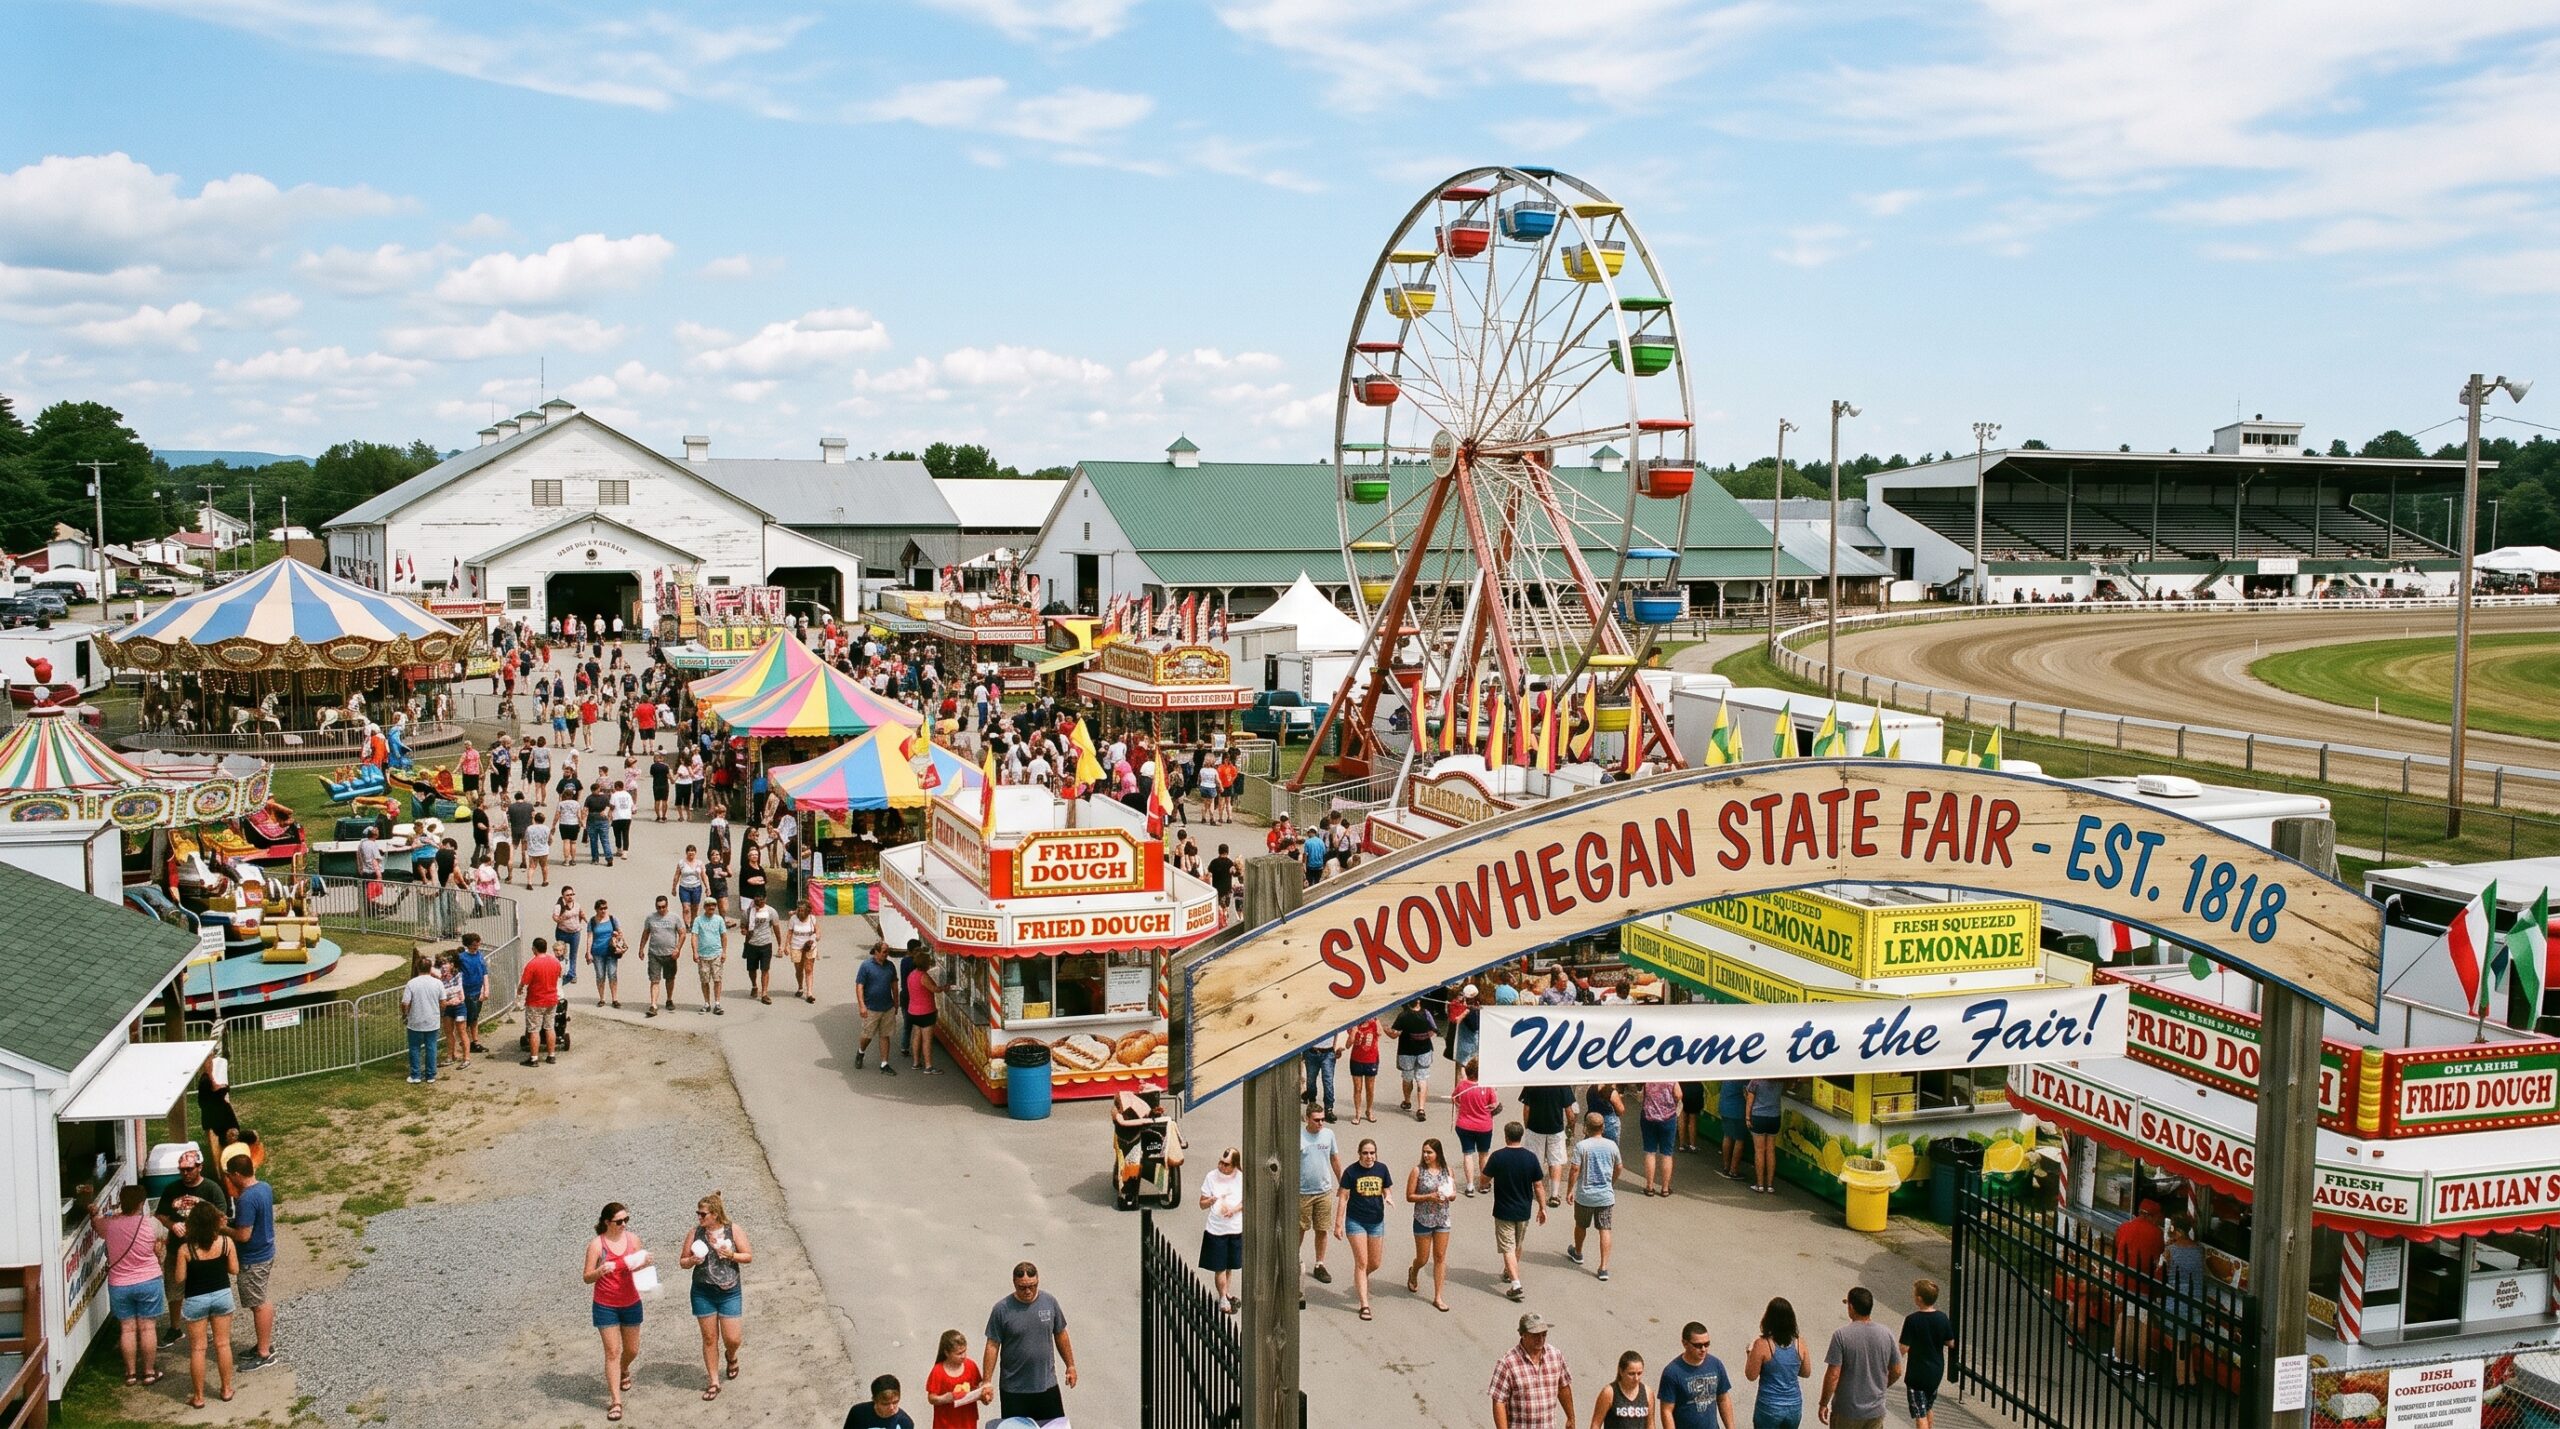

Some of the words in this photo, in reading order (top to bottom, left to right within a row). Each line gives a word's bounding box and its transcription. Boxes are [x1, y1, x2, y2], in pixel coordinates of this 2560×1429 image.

[1038, 842, 1119, 861] FRIED
[1030, 862, 1127, 882] DOUGH
[1320, 808, 1696, 999] SKOWHEGAN
[1717, 788, 1880, 871] STATE
[1901, 791, 2020, 868] FAIR
[2066, 814, 2165, 901] EST.
[2182, 854, 2286, 943] 1818
[1773, 894, 1822, 920] SQUEEZED
[946, 926, 998, 942] DOUGH
[1018, 917, 1085, 940] FRIED
[1091, 914, 1171, 936] DOUGH
[1752, 906, 1853, 961] LEMONADE
[1893, 919, 1938, 934] FRESH
[1942, 914, 2016, 933] SQUEEZED
[1884, 932, 2024, 965] LEMONADE
[1511, 1016, 1767, 1072] Welcome
[1786, 1020, 1840, 1063] to
[1859, 1005, 1940, 1060] the
[1962, 993, 2107, 1063] Fair!
[2127, 1009, 2207, 1061] FRIED
[2406, 1081, 2470, 1114] FRIED
[2475, 1075, 2552, 1109] DOUGH
[2031, 1069, 2132, 1131] ITALIAN
[2141, 1112, 2254, 1177] SAUSAG
[2324, 1174, 2384, 1192] FRESH
[2439, 1175, 2541, 1214] ITALIAN
[2312, 1186, 2408, 1215] AUSAGE
